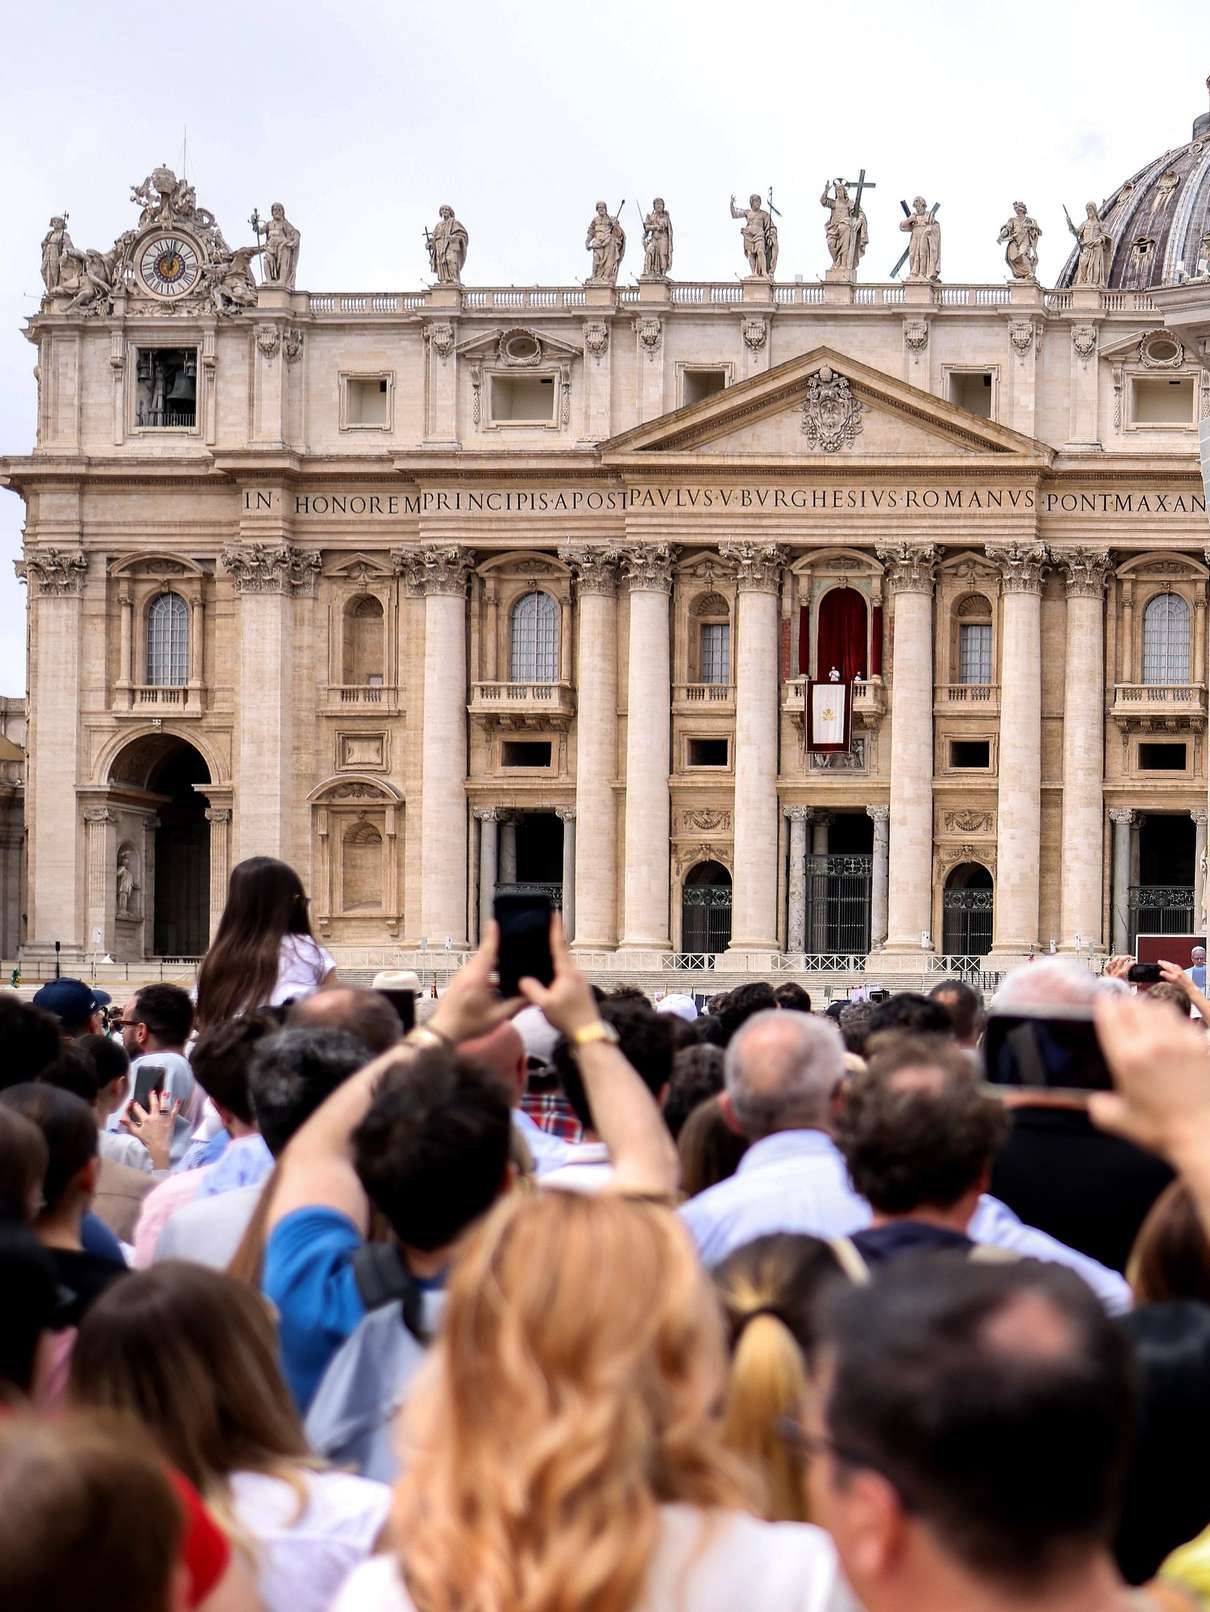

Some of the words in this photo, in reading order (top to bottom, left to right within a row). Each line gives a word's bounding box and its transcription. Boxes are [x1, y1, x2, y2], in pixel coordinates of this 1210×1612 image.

[244, 491, 273, 510] IN
[295, 496, 421, 514] HONOREM
[423, 492, 548, 511] PRINCIPIS
[554, 491, 628, 511] APOST
[630, 488, 713, 507] PAVLVS
[720, 489, 733, 507] V
[741, 489, 897, 508] BVRGHESIVS
[906, 489, 1035, 508] ROMANVS
[1046, 493, 1112, 512] PONT
[1115, 494, 1169, 512] MAX
